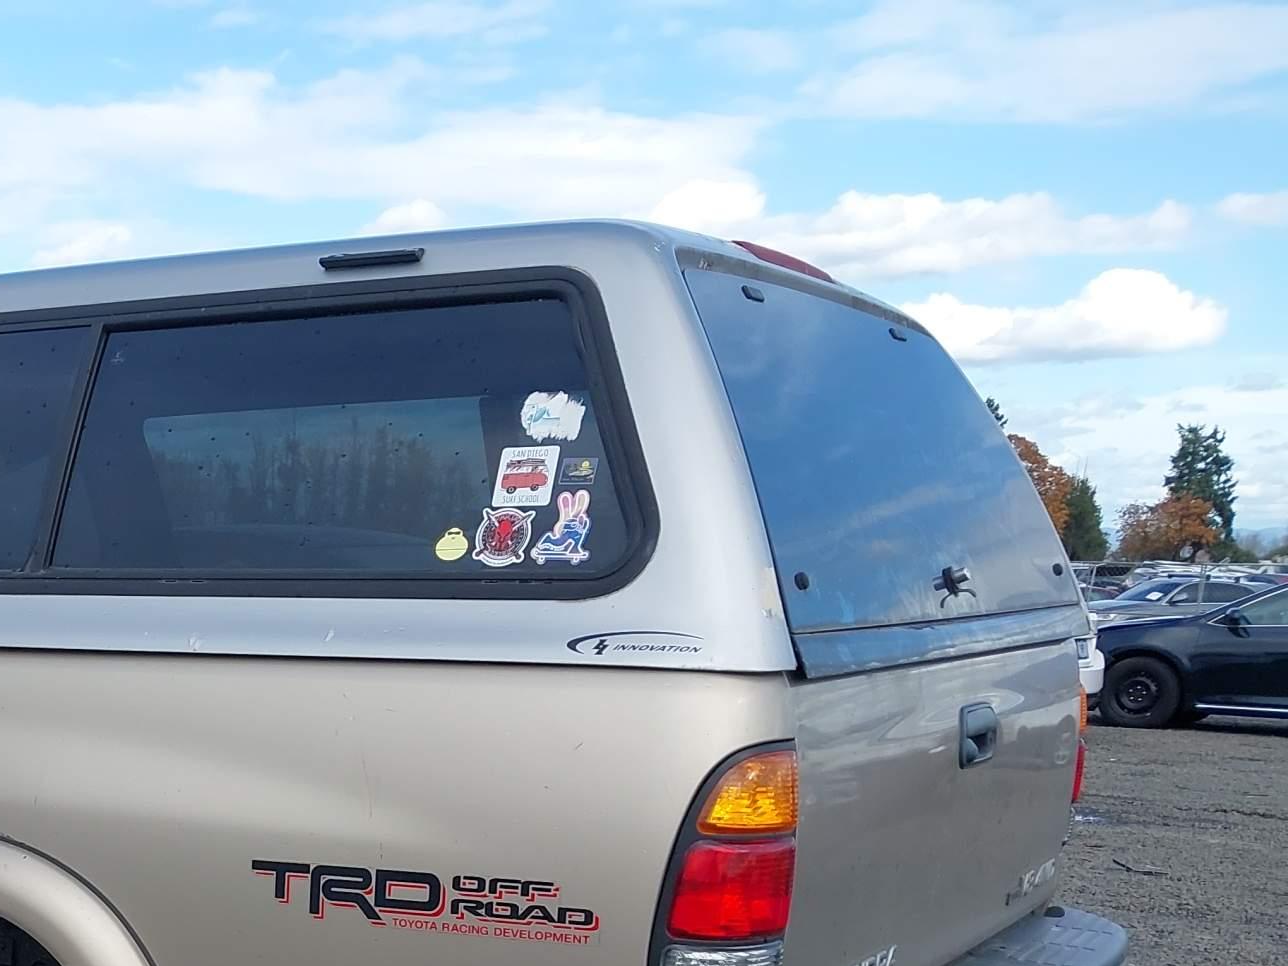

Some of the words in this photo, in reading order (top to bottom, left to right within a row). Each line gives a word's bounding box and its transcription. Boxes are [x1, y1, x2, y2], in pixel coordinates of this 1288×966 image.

[511, 448, 527, 458] SAN
[527, 448, 550, 458] DIEGO
[612, 643, 704, 654] INNOVATION
[252, 859, 446, 927] TRD
[451, 874, 561, 903] OFF
[450, 897, 600, 931] ROAD
[392, 917, 438, 931] TOYOTA
[441, 923, 489, 937] RACING
[493, 928, 590, 945] DEVELOPMENT
